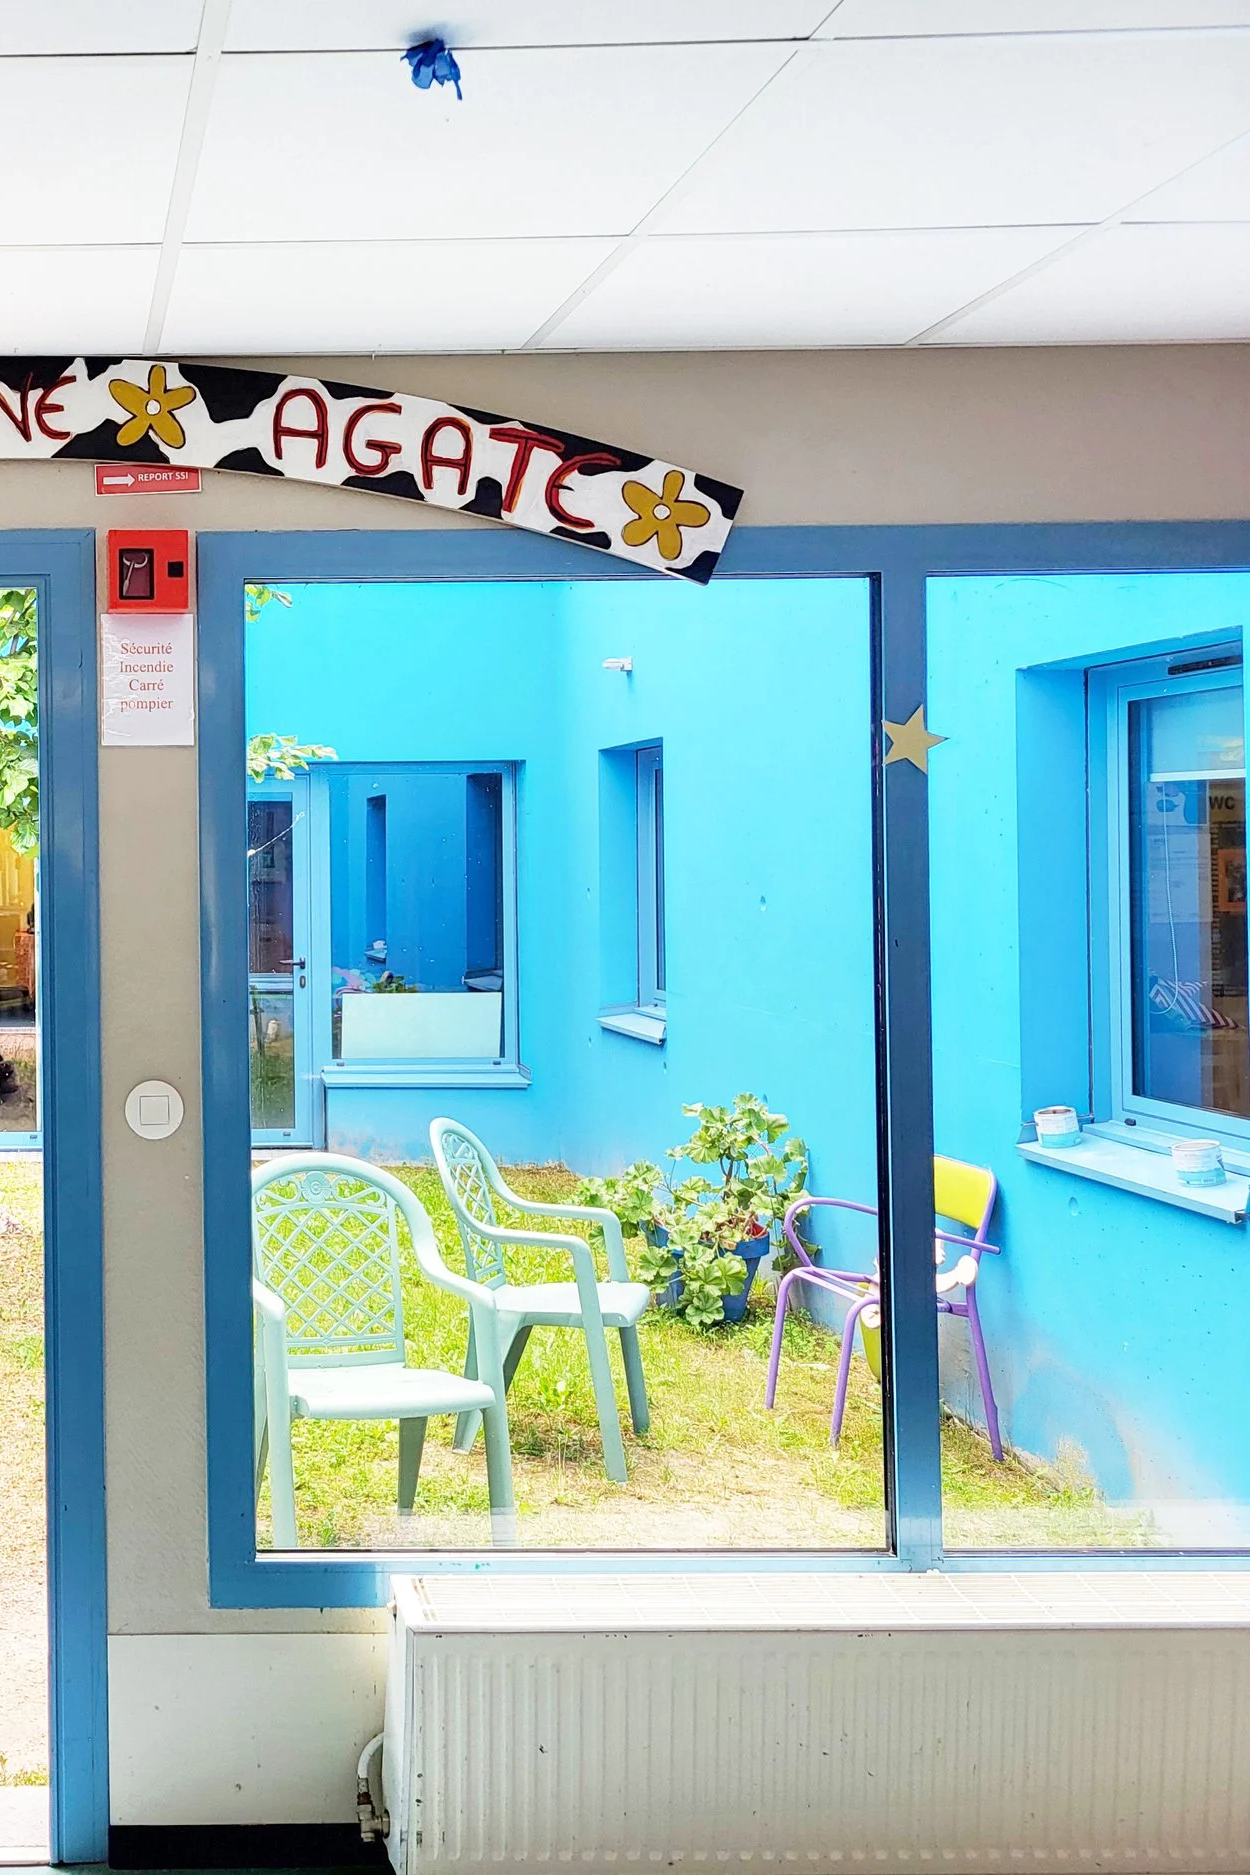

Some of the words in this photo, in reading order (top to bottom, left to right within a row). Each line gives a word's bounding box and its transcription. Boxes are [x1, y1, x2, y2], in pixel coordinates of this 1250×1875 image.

[272, 388, 622, 530] AGATE
[138, 472, 173, 482] REPORT
[175, 471, 189, 480] SSI
[120, 642, 173, 655] Sécurité
[119, 661, 174, 673] Incendie
[128, 678, 165, 691] Carré
[120, 696, 174, 713] pompier
[1209, 795, 1236, 811] WC
